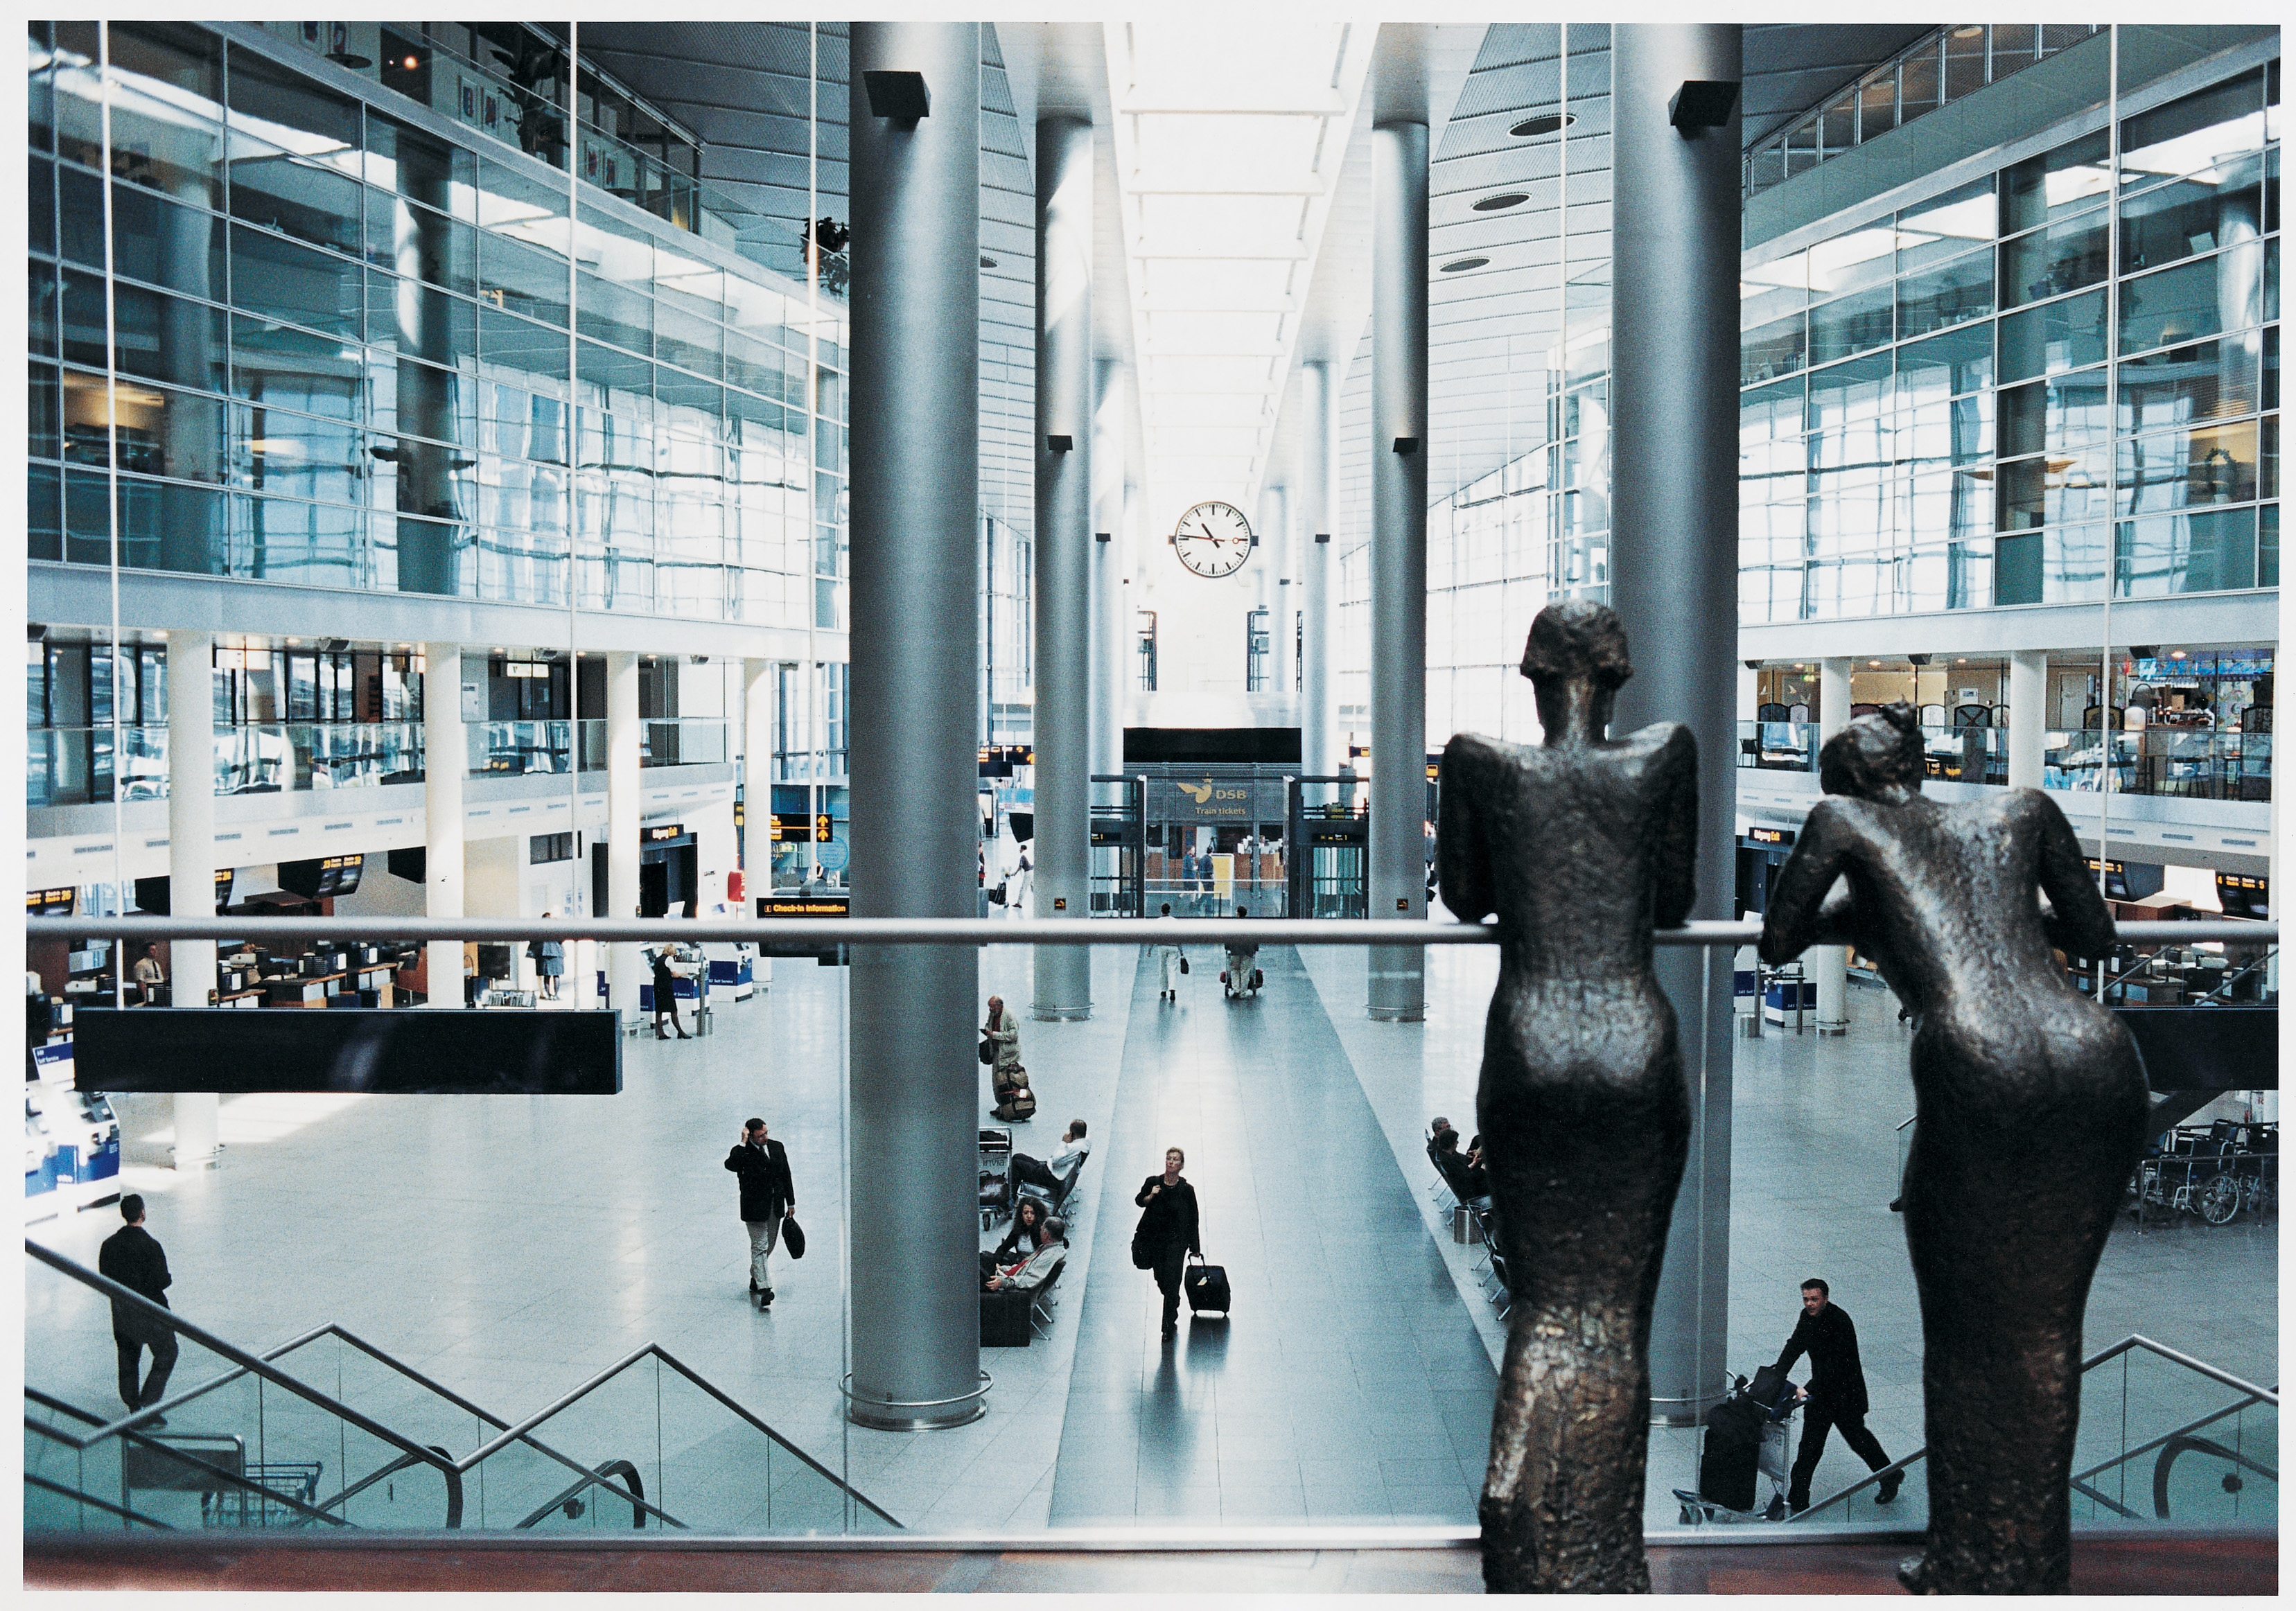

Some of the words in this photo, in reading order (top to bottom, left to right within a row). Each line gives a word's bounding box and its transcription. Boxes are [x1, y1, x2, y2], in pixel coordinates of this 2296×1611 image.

[1216, 790, 1247, 800] DSB
[669, 827, 678, 837] Exit
[1771, 831, 1780, 842] Exit
[2117, 863, 2122, 873] 3
[2217, 875, 2223, 885] 4
[2259, 879, 2265, 890] 5
[773, 904, 805, 913] Check-in
[805, 904, 847, 913] Information
